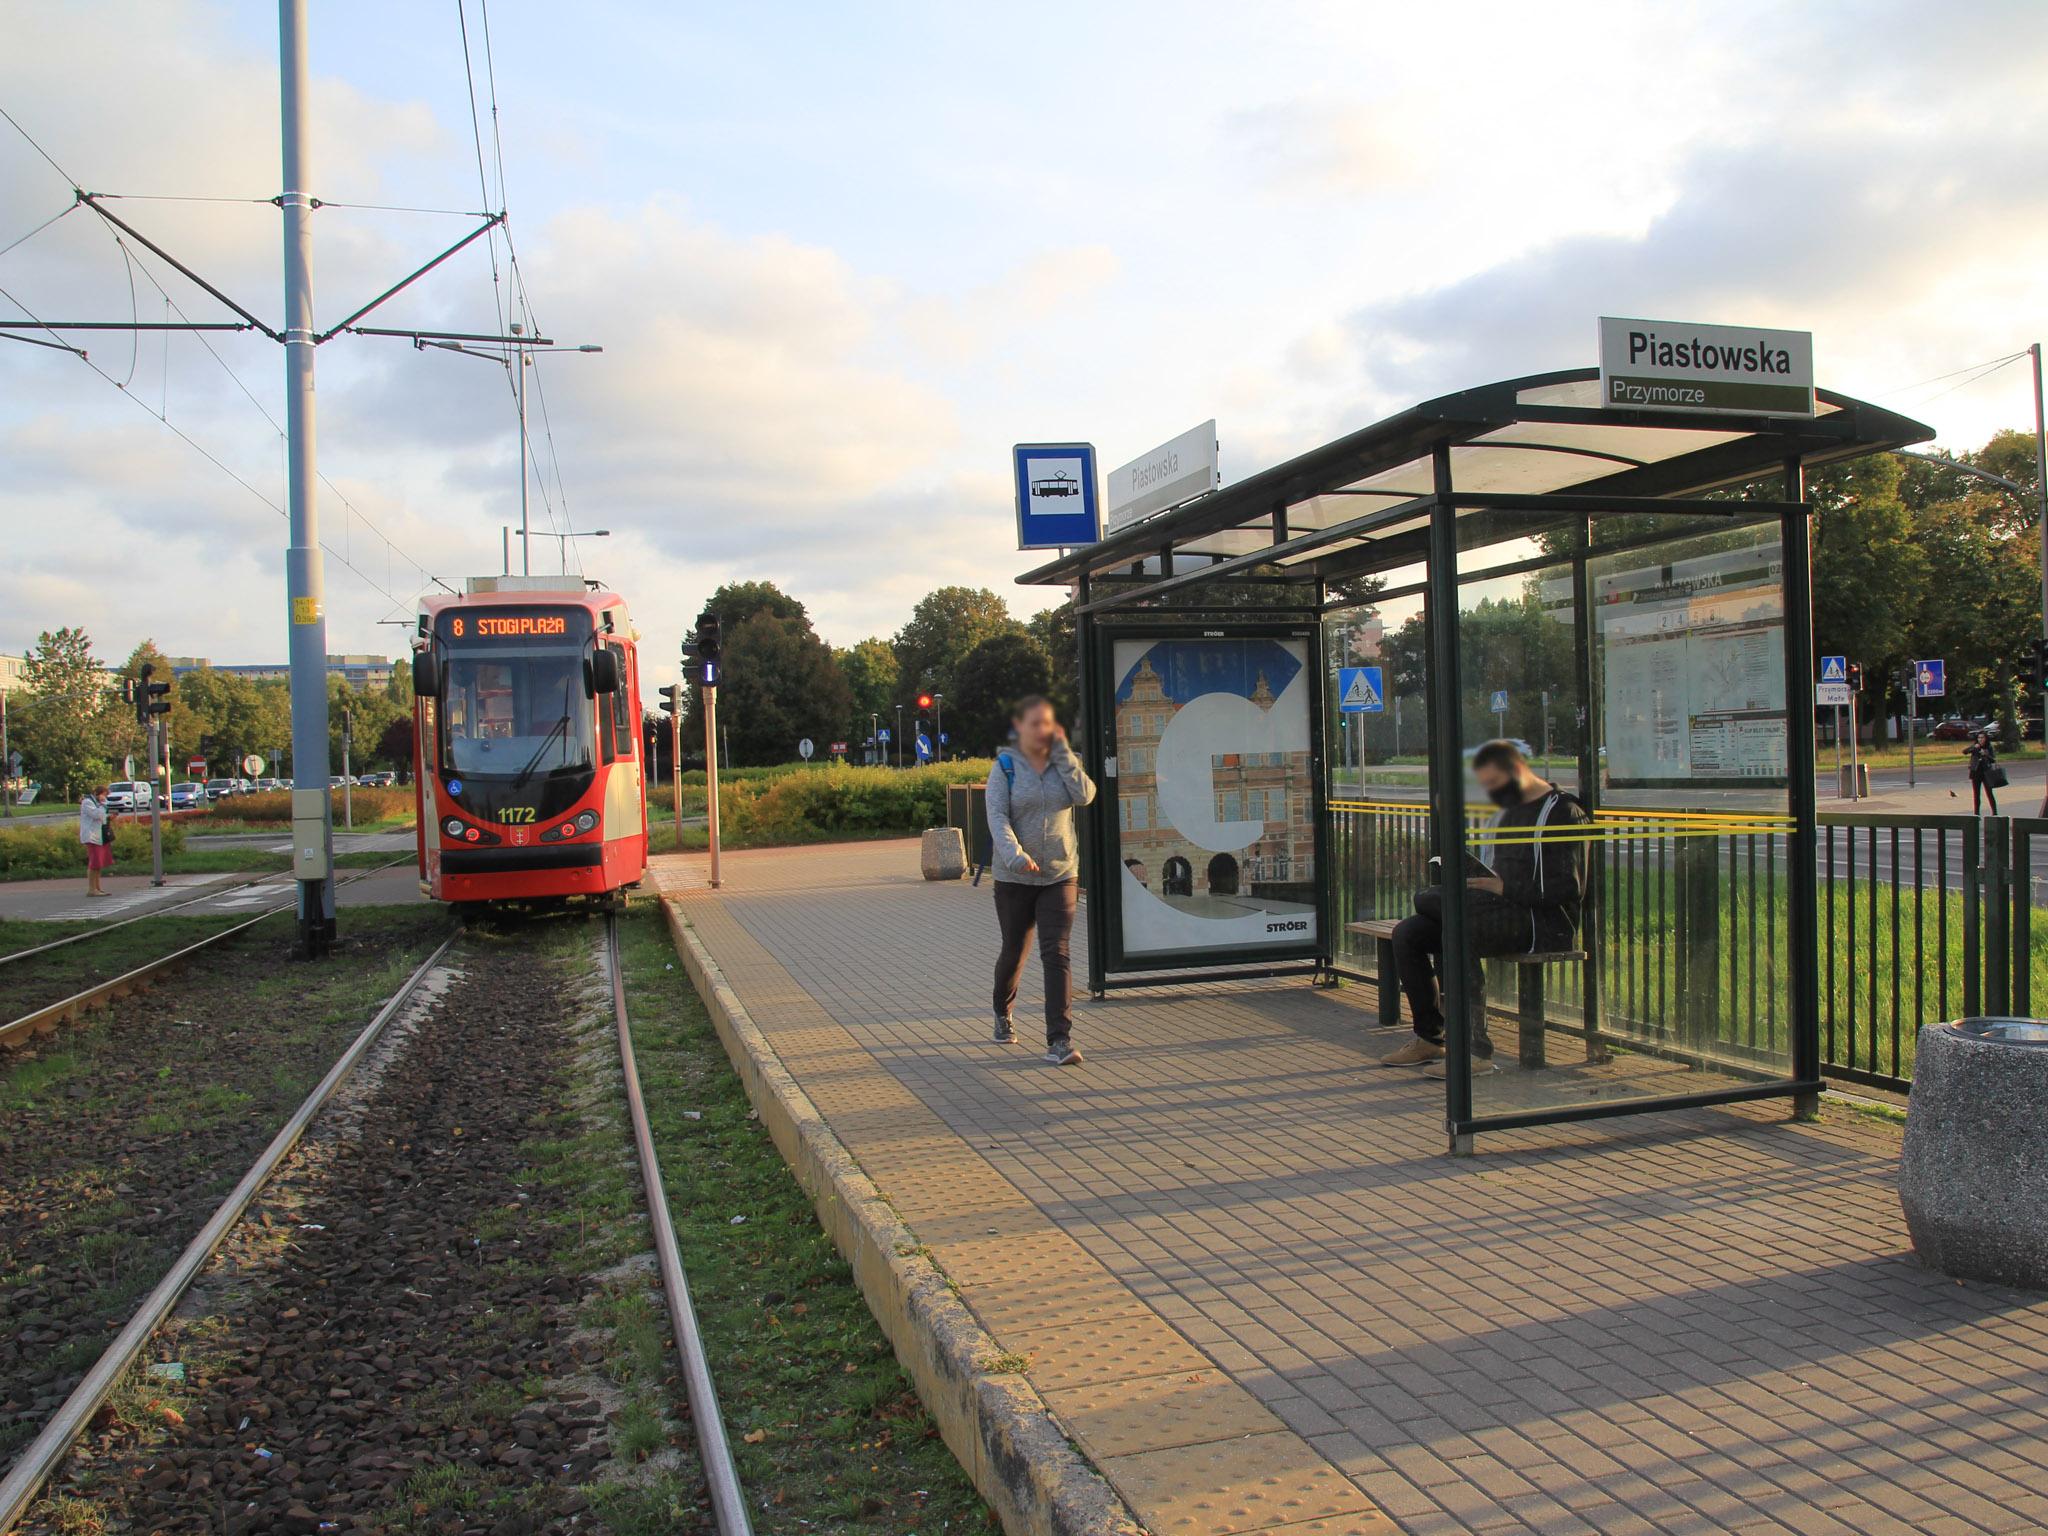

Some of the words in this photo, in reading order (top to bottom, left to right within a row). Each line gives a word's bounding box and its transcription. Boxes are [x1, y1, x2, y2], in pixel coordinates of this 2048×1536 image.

[1629, 331, 1791, 374] Piastowska
[1613, 380, 1705, 404] Przymorze
[1132, 450, 1179, 493] Piastowska
[453, 618, 464, 637] 8
[478, 618, 519, 635] STOGI
[520, 616, 565, 634] PLAŻA
[498, 807, 536, 823] 1172
[1266, 920, 1308, 933] STRÖER
